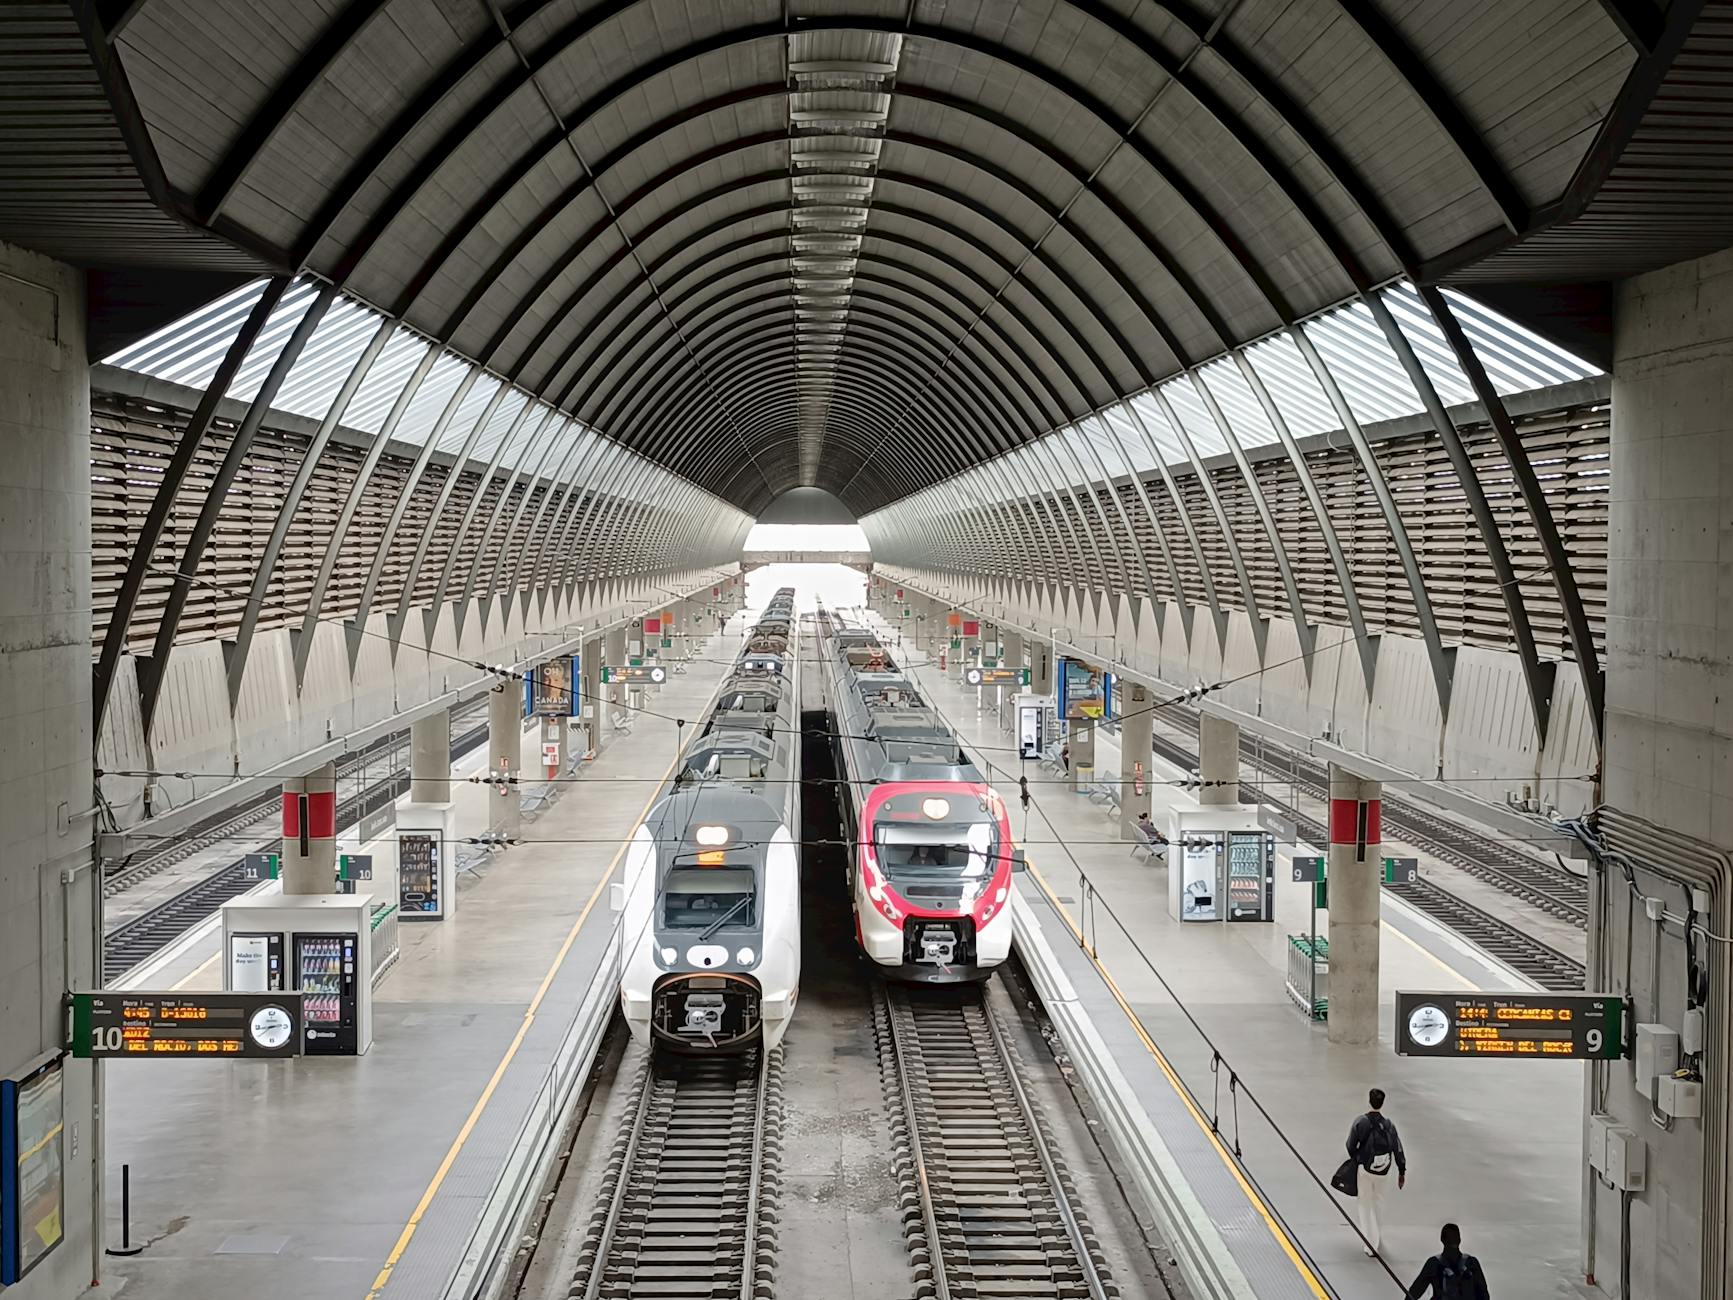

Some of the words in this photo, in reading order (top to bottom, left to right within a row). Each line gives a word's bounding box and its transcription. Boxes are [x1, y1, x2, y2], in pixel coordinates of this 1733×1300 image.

[543, 667, 559, 676] OH
[246, 868, 258, 878] 11
[359, 869, 371, 880] 10
[1294, 868, 1302, 880] 9
[1407, 870, 1416, 882] 8
[92, 1027, 123, 1051] 10
[1586, 1028, 1603, 1052] 9
